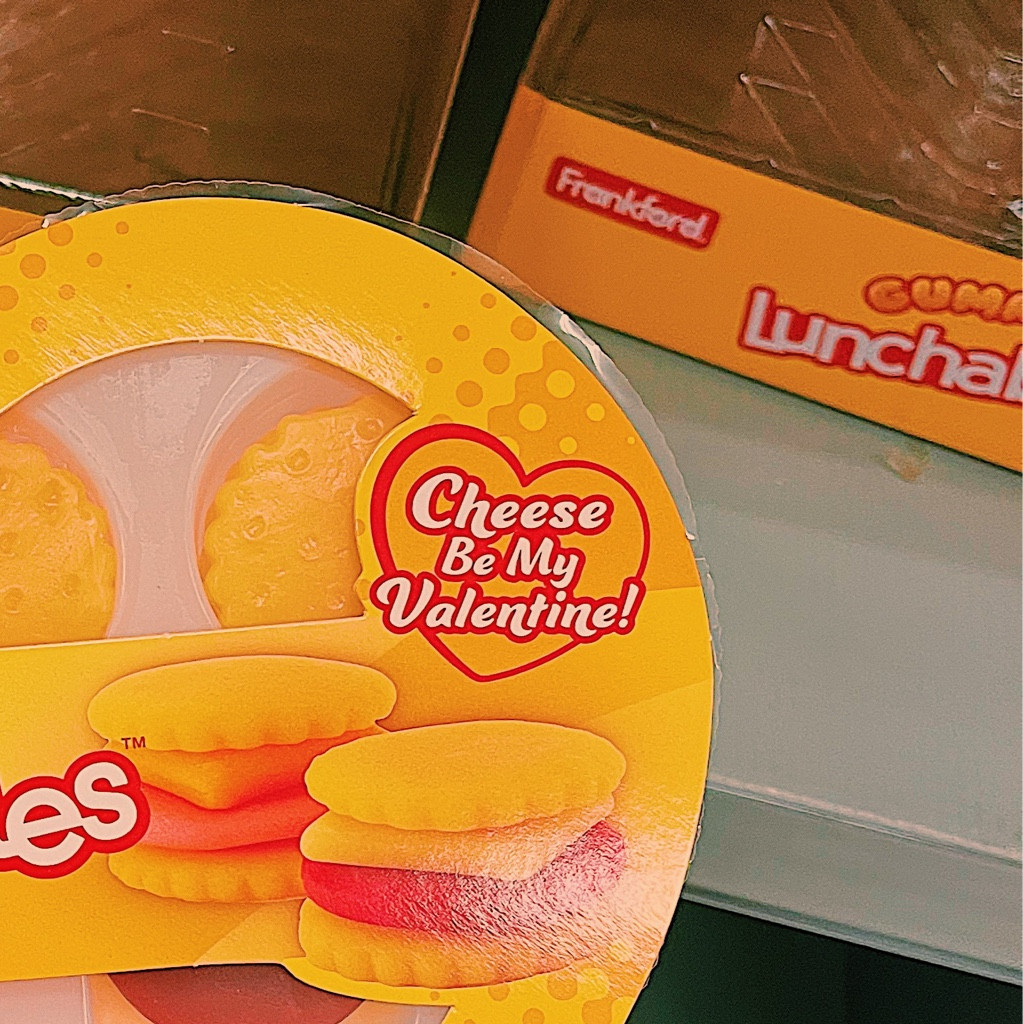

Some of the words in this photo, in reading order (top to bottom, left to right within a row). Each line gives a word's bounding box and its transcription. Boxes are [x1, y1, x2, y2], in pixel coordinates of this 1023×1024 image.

[411, 471, 608, 540] Cheese
[440, 536, 496, 577] Be
[505, 536, 580, 590] My
[375, 576, 640, 637] Valentine!
